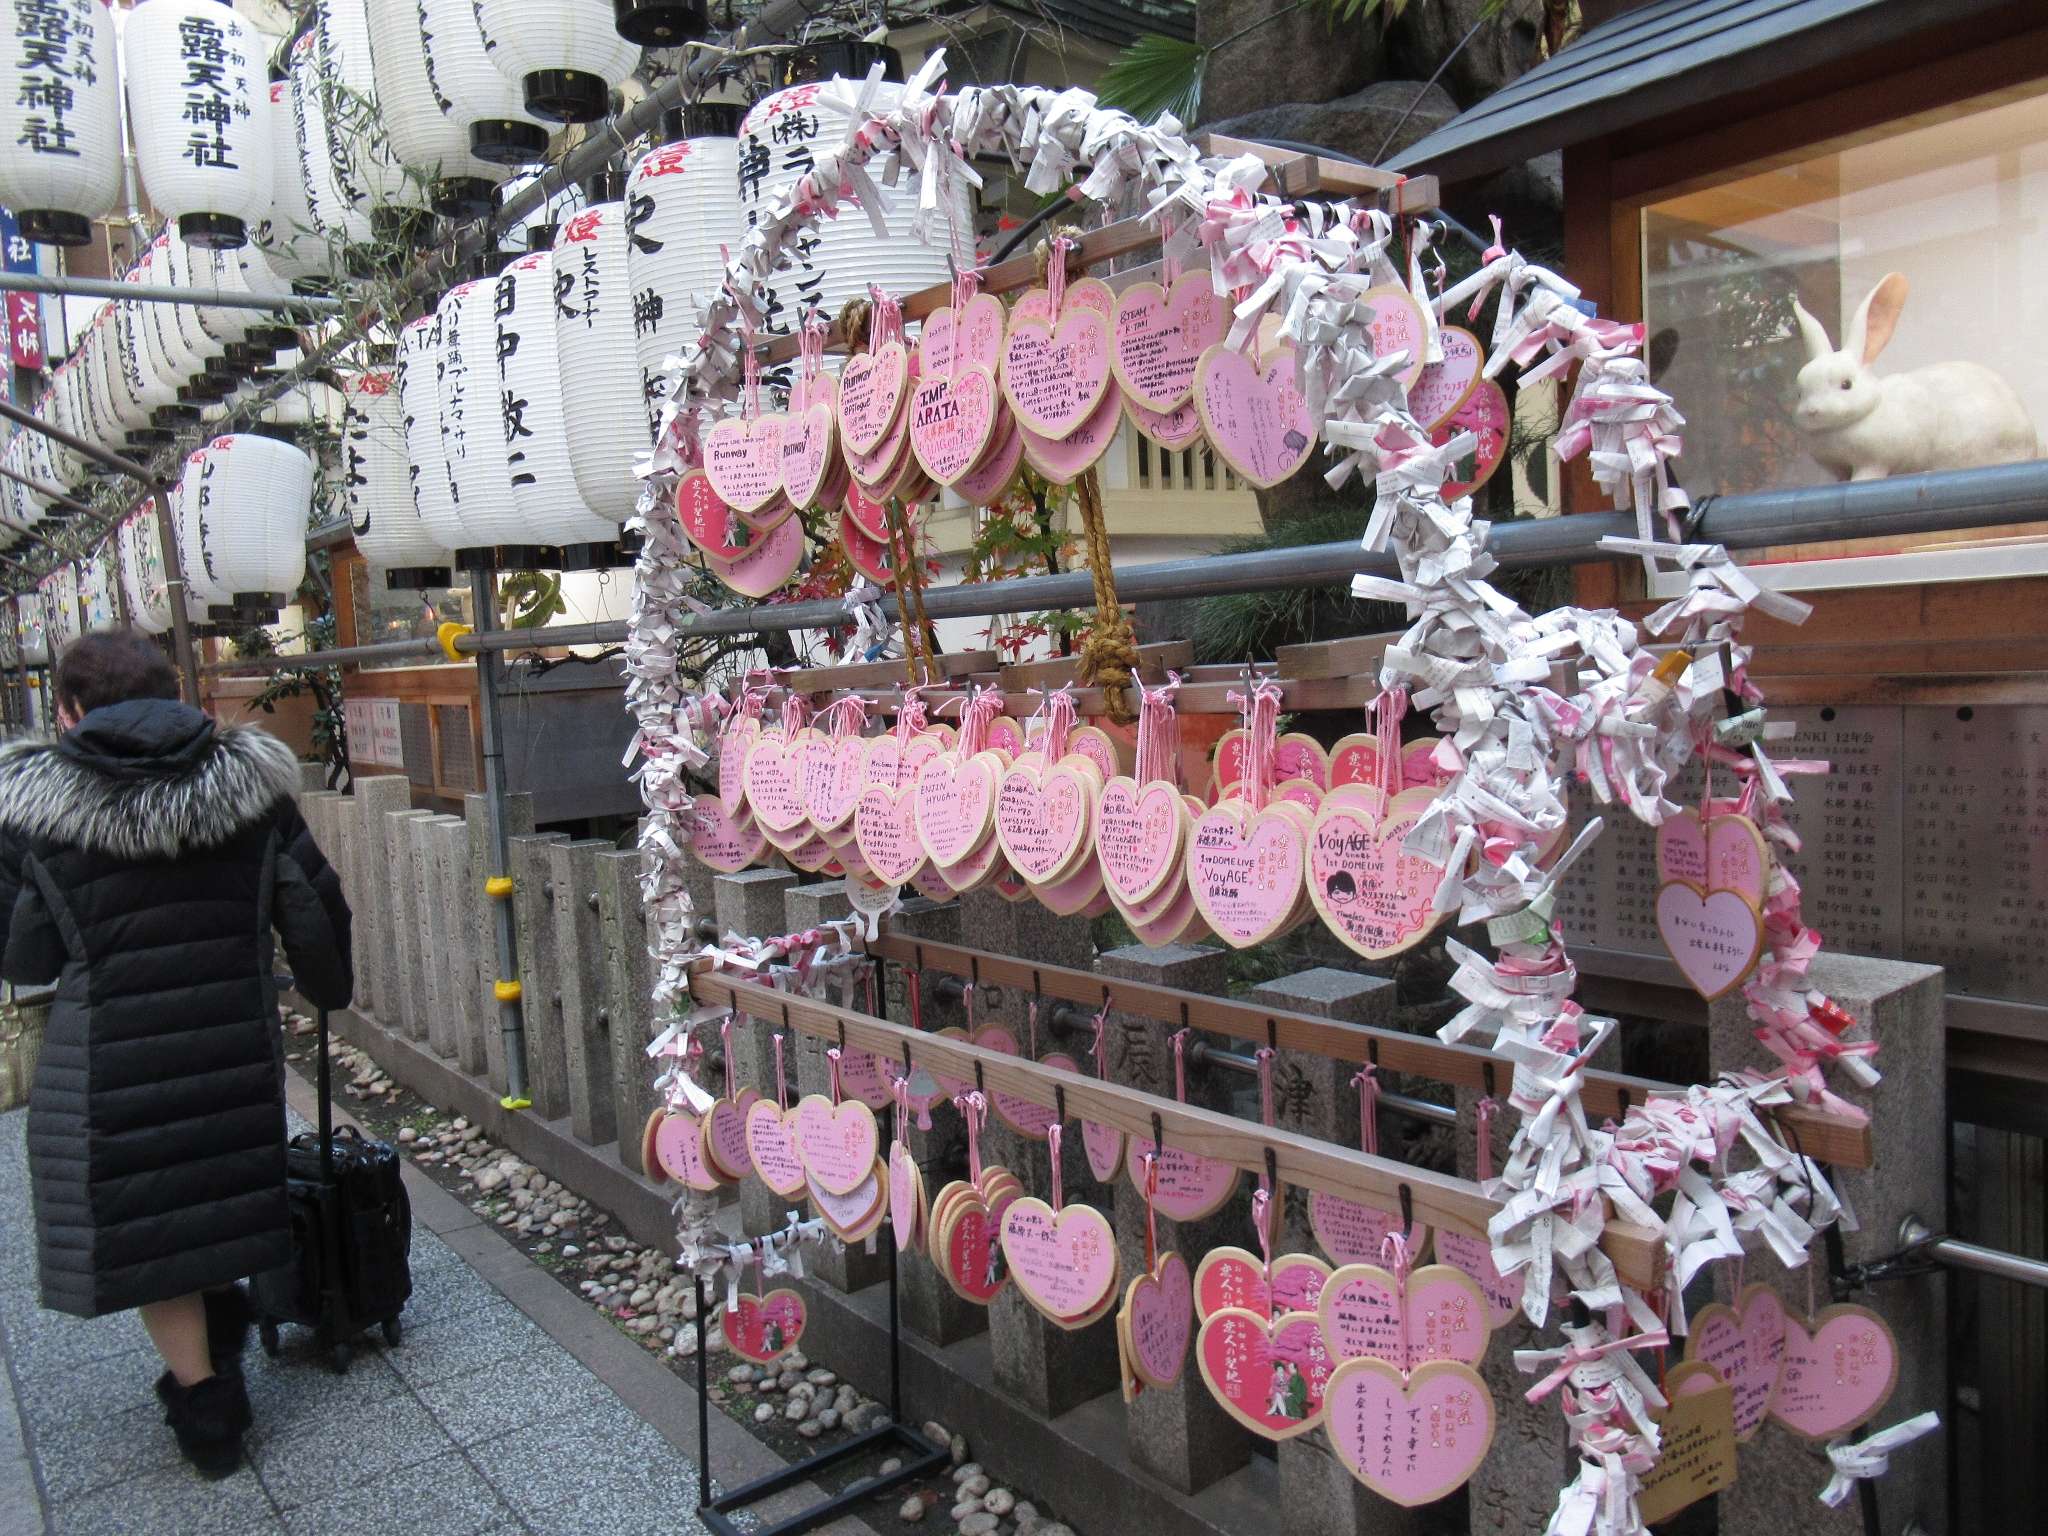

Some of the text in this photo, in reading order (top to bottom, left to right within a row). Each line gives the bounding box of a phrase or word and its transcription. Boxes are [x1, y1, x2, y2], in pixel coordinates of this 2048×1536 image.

[14, 0, 81, 156] 露天神社
[179, 16, 239, 169] 露天神社
[227, 21, 250, 120] お初天神
[916, 400, 960, 428] ARATA
[714, 449, 747, 461] Runway
[1204, 867, 1248, 887] VoyAGE
[1212, 855, 1237, 867] DOME
[1237, 857, 1255, 868] LIVE
[1318, 833, 1370, 856] VoyAGE
[1341, 860, 1367, 870] DOME
[1367, 861, 1385, 872] LIVE
[1222, 1319, 1243, 1384] 恋人の聖地
[1354, 1382, 1369, 1474] 出会えますように
[1382, 1397, 1393, 1477] してくれる人に
[1406, 1407, 1421, 1472] ずっと幸せに
